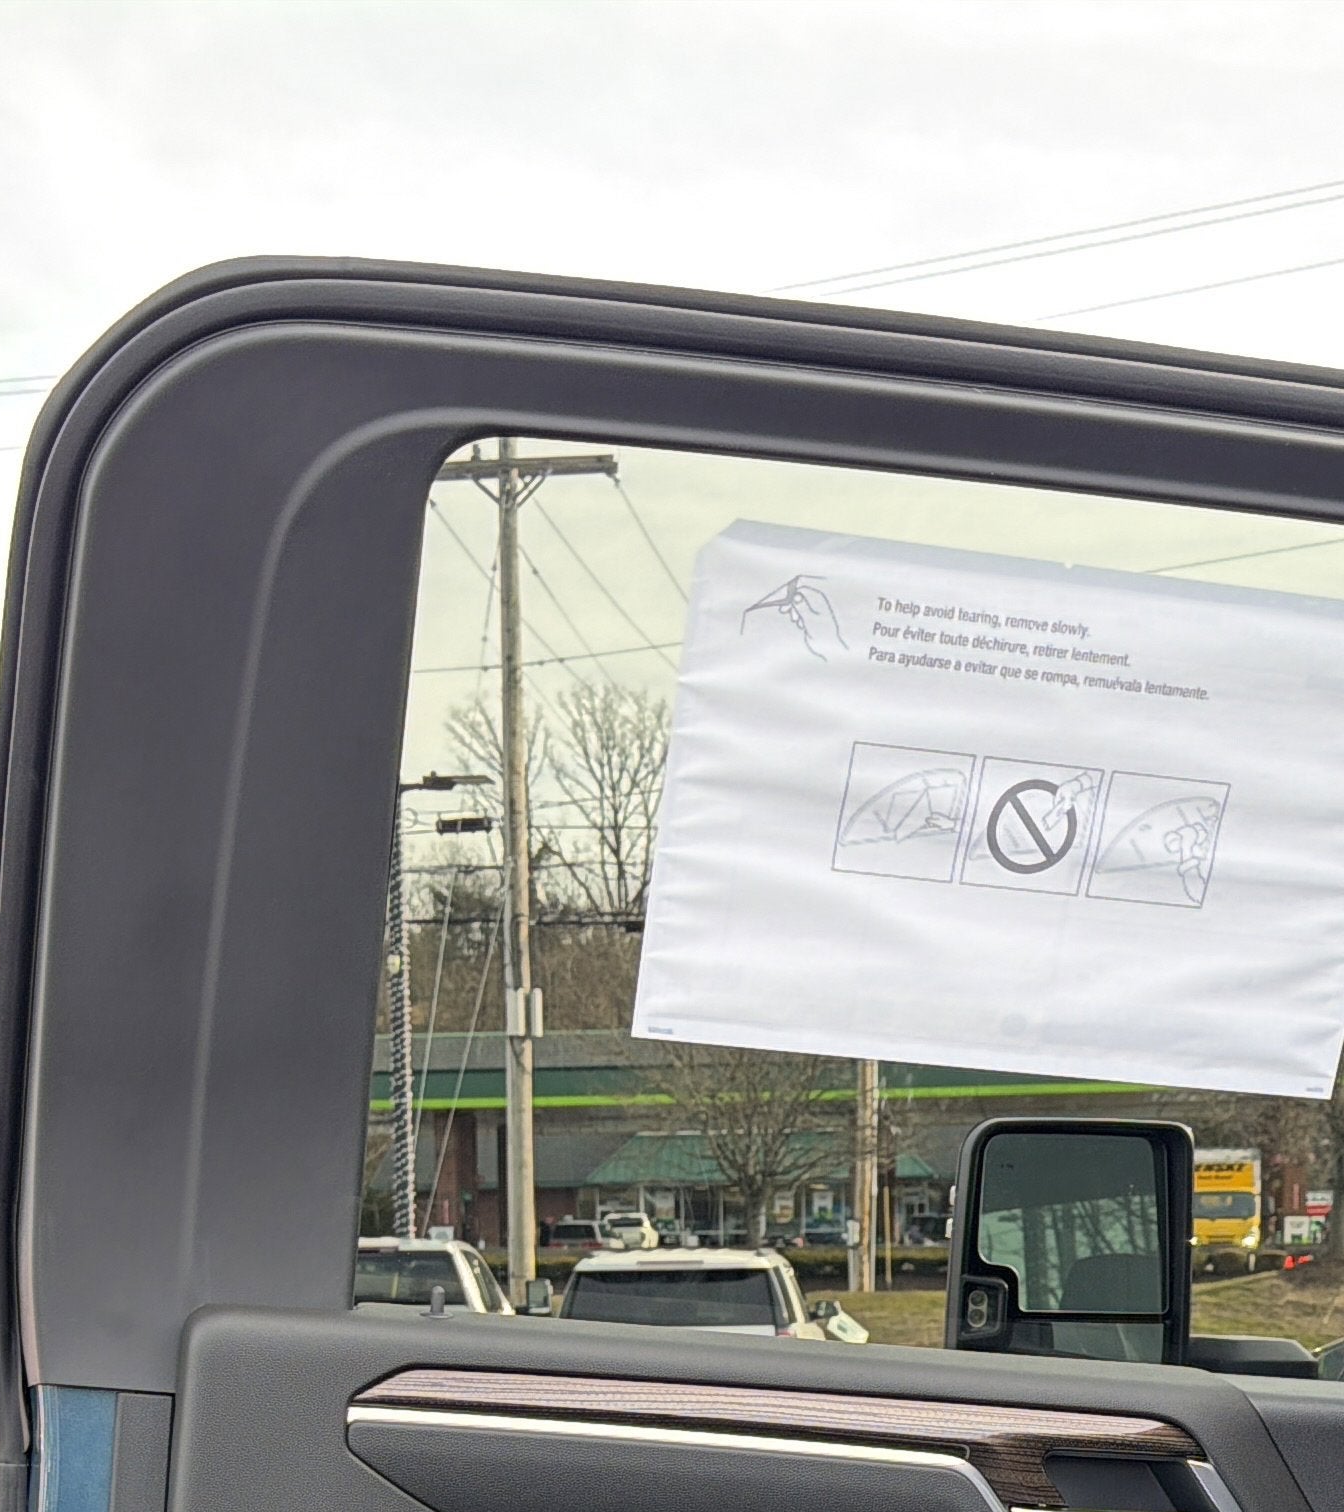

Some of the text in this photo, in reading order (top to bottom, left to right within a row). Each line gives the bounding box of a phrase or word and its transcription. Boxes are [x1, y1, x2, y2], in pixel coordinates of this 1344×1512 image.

[877, 597, 892, 612] To
[895, 599, 920, 617] help
[923, 605, 955, 620] avoid
[958, 608, 1001, 629] tearing,
[1005, 617, 1049, 632] remove
[872, 621, 901, 638] Pour
[903, 625, 937, 642] éviter
[939, 631, 969, 647] toute
[972, 635, 1029, 657] déchirure,
[1033, 644, 1069, 659] retirer
[868, 646, 895, 663] Para
[898, 653, 952, 670] ayudarse
[953, 659, 962, 671] a
[964, 660, 998, 675] evitar
[1000, 666, 1022, 680] que
[1024, 668, 1039, 680] se
[1041, 671, 1080, 687] rompa,
